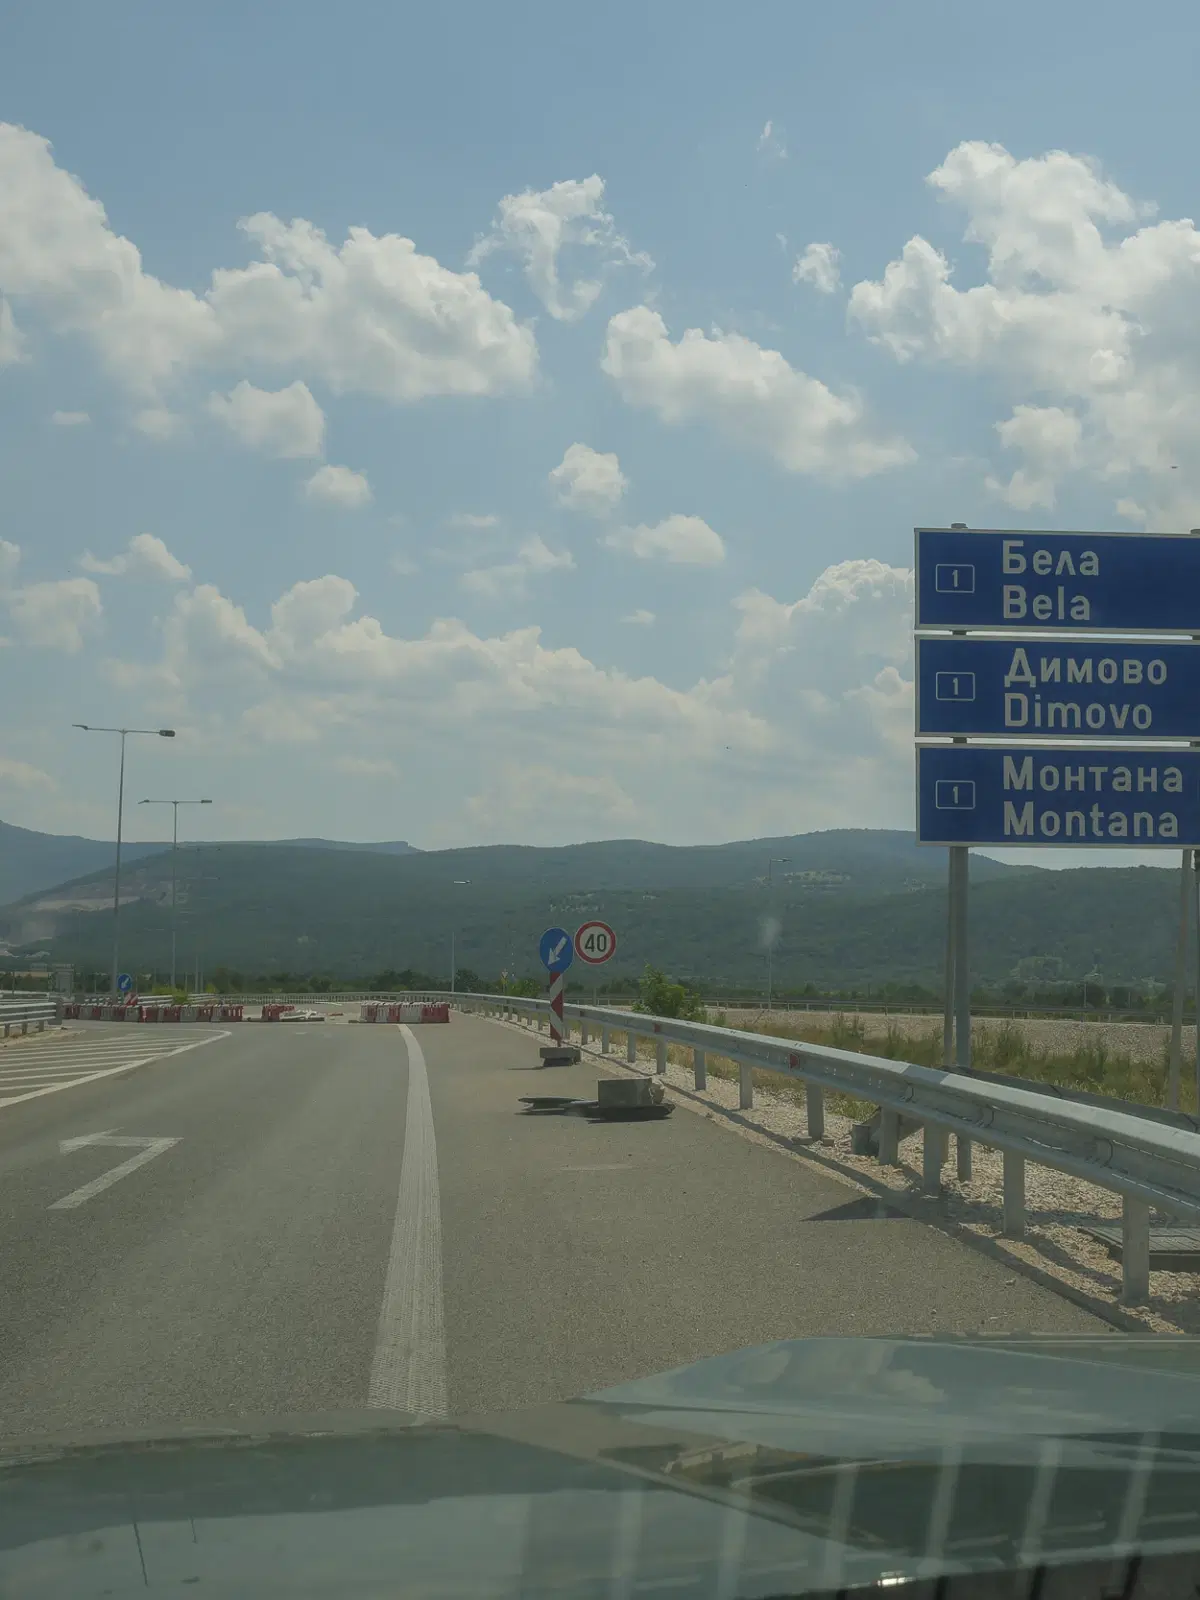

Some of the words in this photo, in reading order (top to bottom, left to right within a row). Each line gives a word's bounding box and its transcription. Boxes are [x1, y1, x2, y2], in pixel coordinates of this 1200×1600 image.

[1002, 540, 1100, 577] Бела
[1003, 585, 1091, 621] Bela
[1003, 647, 1168, 688] Димово
[1004, 692, 1153, 730] Dimovo
[1003, 755, 1183, 793] Монтана
[1003, 801, 1179, 838] Montana
[584, 933, 607, 953] 40
